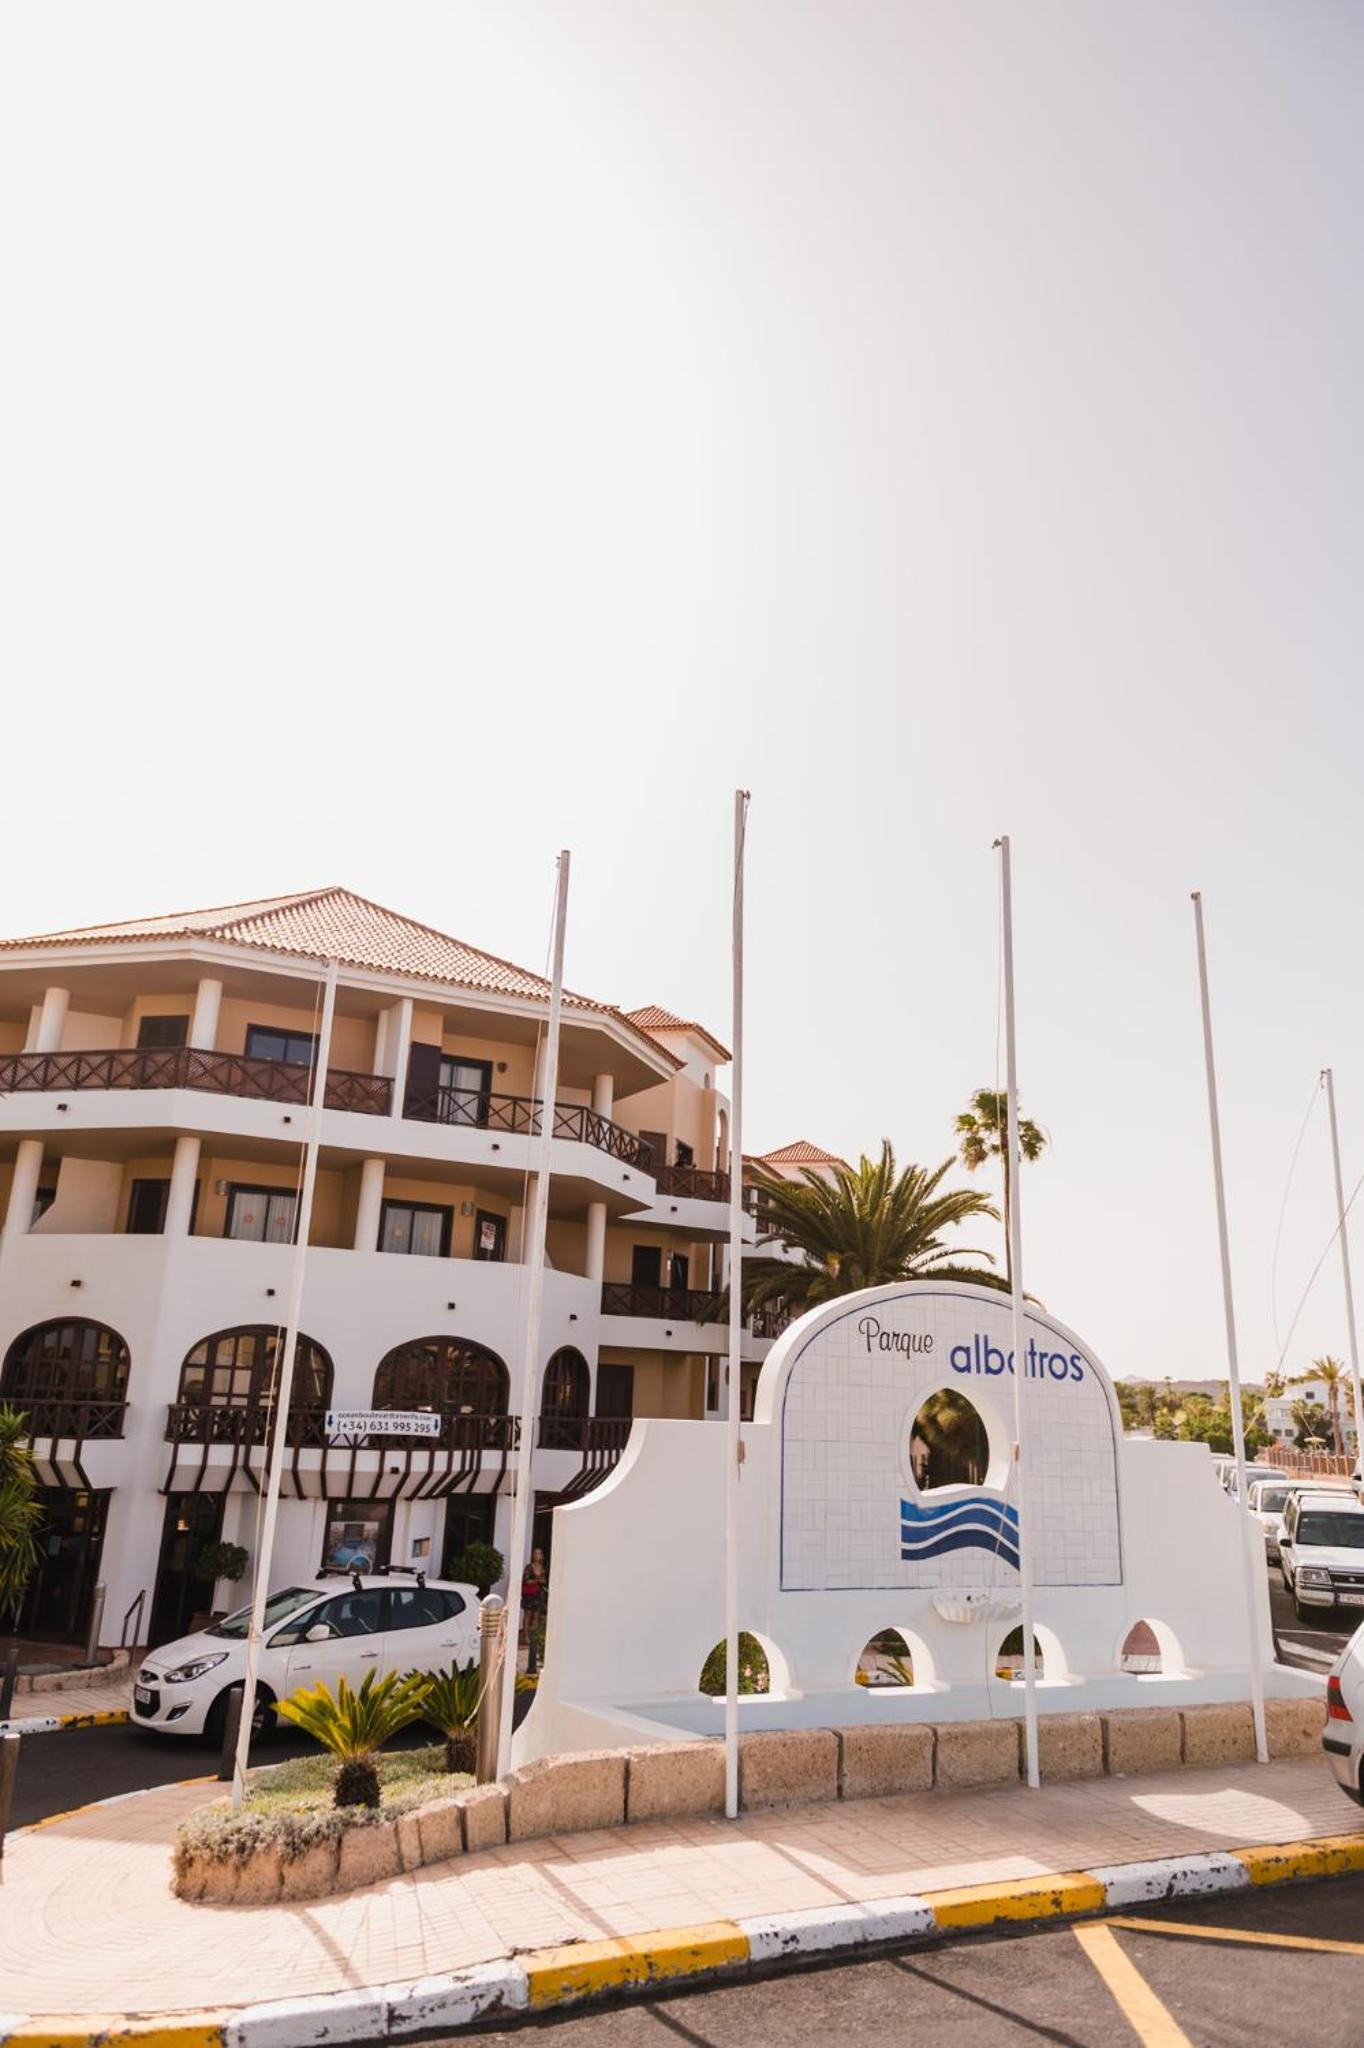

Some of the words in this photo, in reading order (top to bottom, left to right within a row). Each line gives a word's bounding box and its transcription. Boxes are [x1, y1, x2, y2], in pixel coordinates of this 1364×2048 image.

[858, 1316, 934, 1360] Parque
[337, 1420, 367, 1432] (+34)
[369, 1421, 389, 1431] 631
[392, 1421, 412, 1432] 995
[413, 1422, 431, 1433] 295
